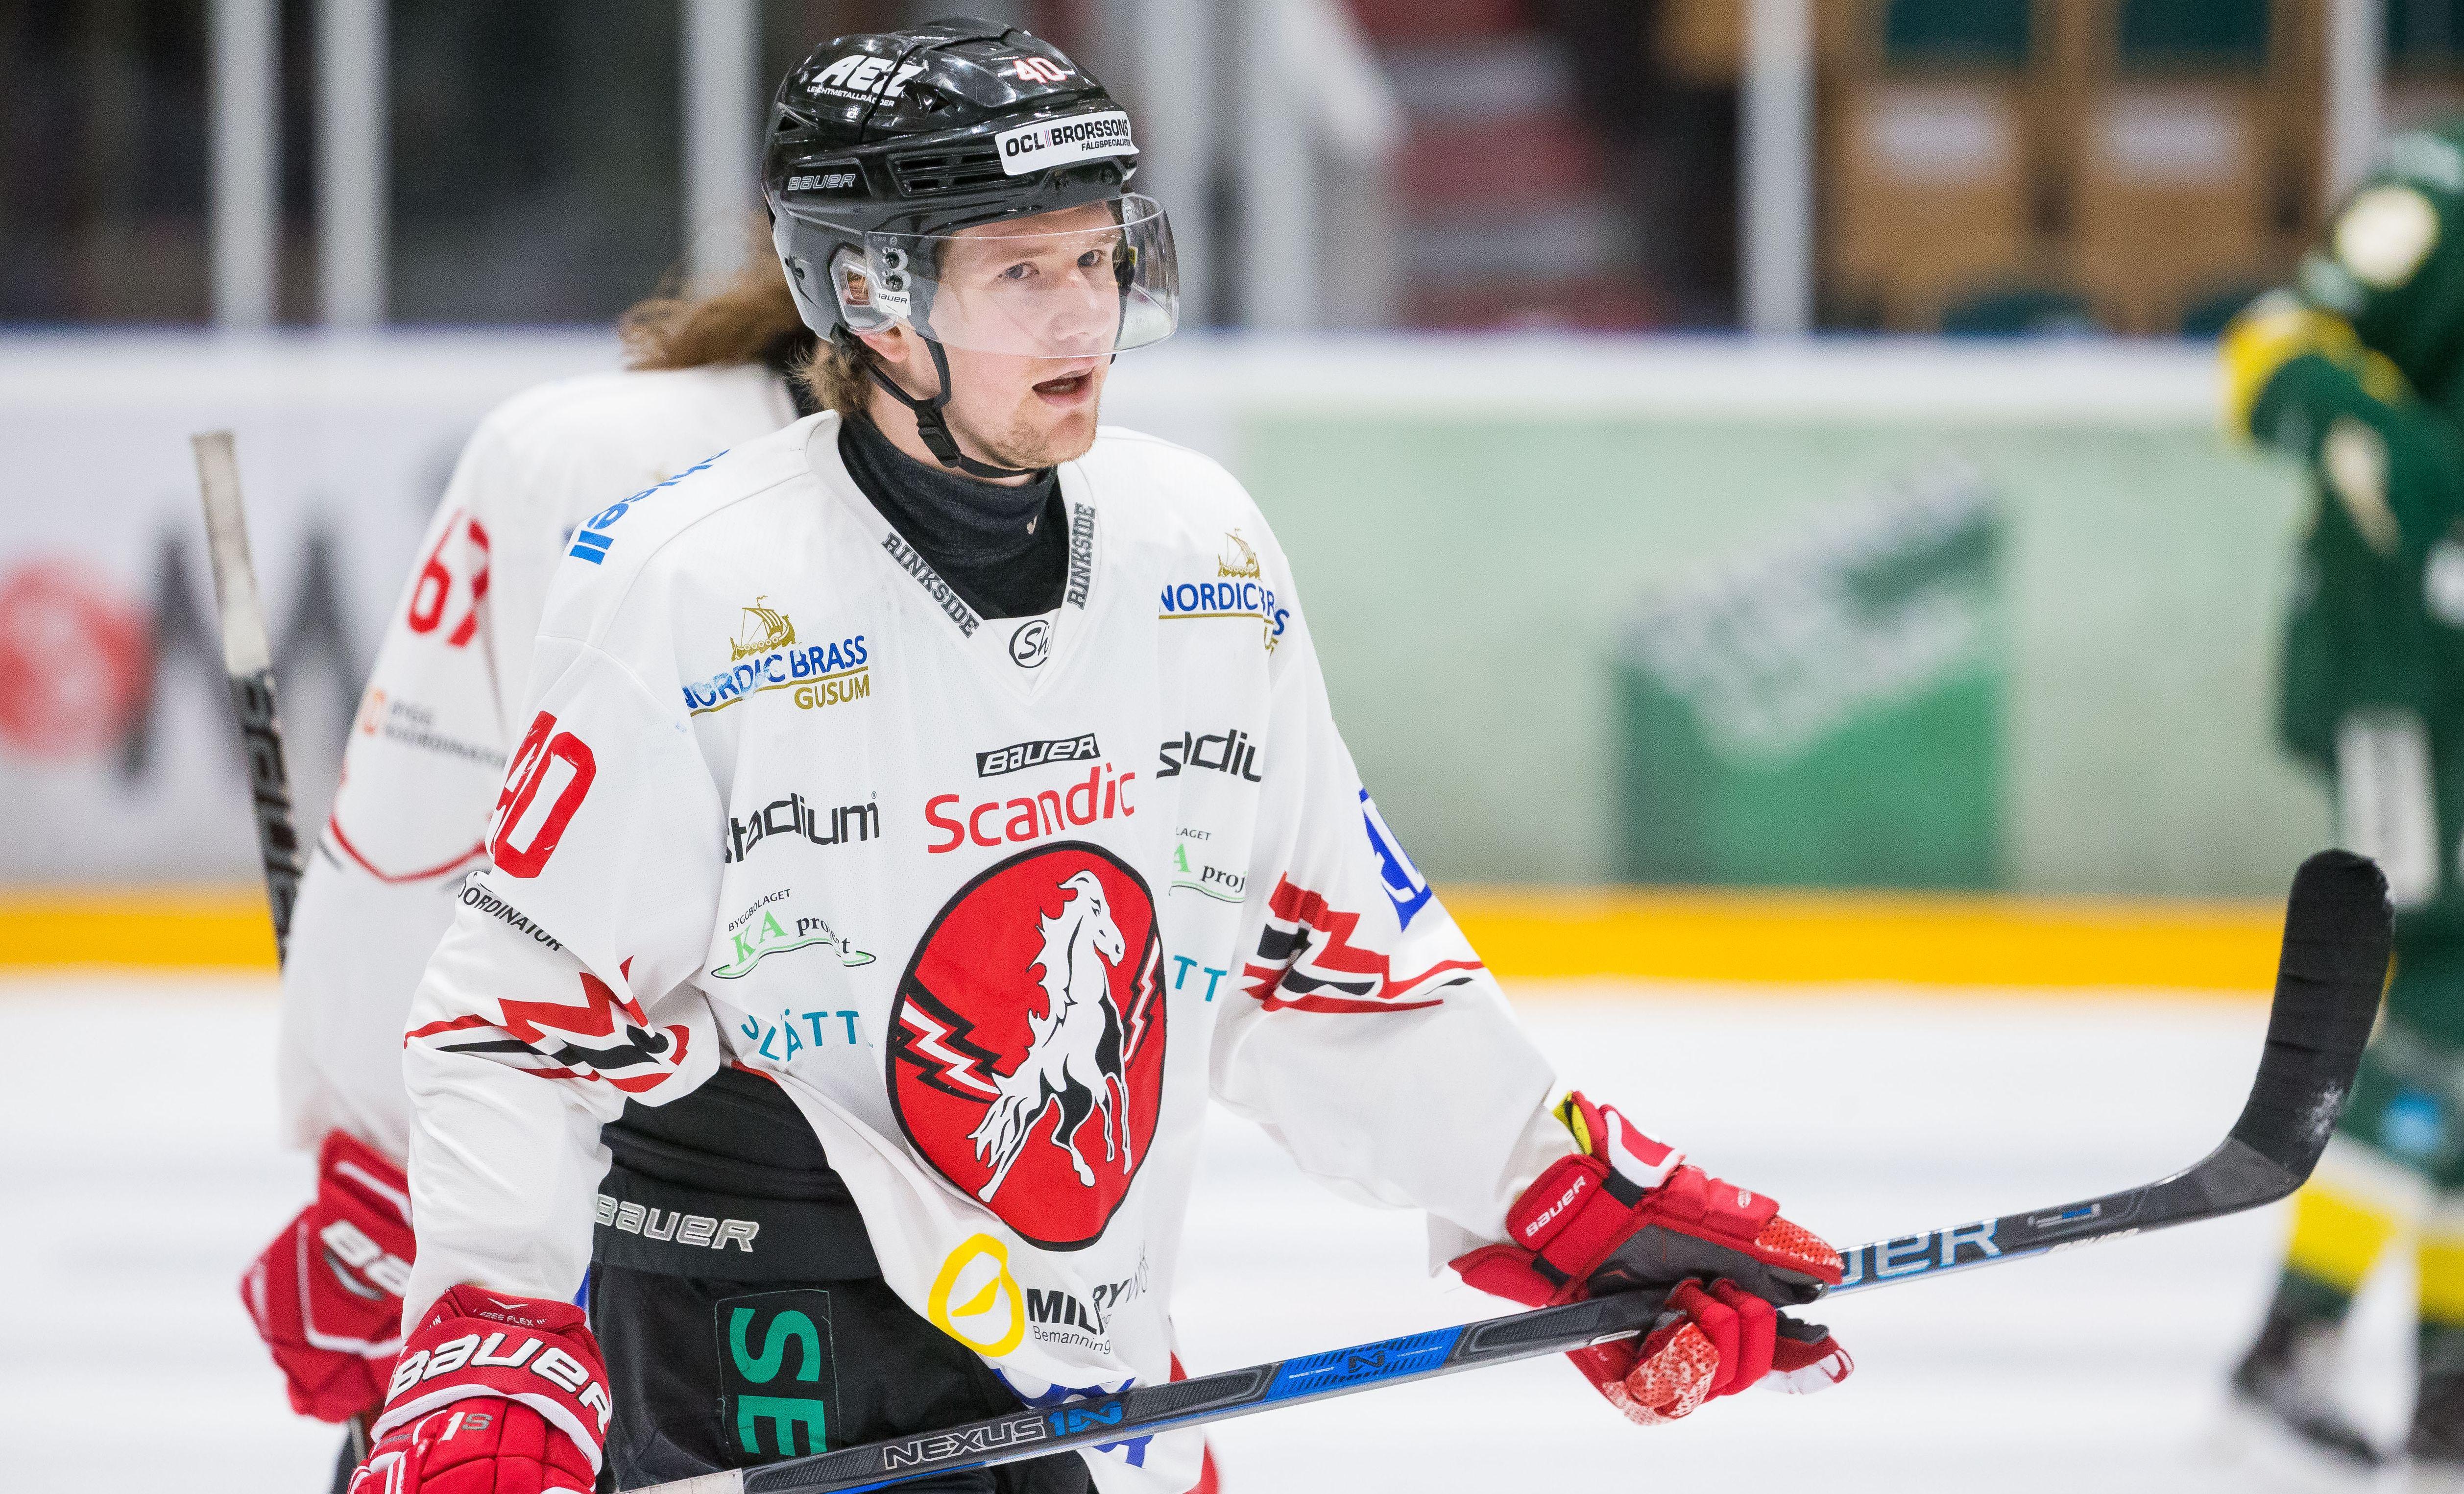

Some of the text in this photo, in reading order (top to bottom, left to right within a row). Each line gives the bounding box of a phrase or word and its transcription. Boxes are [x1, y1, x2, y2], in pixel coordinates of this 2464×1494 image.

[1013, 57, 1067, 84] 40
[1006, 119, 1129, 157] OCL BRORSSONS
[788, 173, 856, 191] BAUER
[1067, 501, 1096, 610] RINKSIDE
[881, 532, 980, 639] RINKSIDE
[1159, 582, 1258, 612] NORDIC
[682, 635, 868, 710] NORDIC BRASS
[794, 674, 870, 710] GUSUM
[982, 735, 1096, 775] BAUER
[490, 710, 597, 879] 40
[925, 762, 1135, 854] Scandic
[728, 888, 791, 932] BYGGBOLAGET
[730, 909, 789, 966] KA
[594, 1193, 759, 1252] BAUER
[1525, 1175, 1587, 1237] BAUER
[1032, 1325, 1111, 1355] Bemanning
[384, 1332, 612, 1436] BAUER
[440, 1412, 494, 1441] 1S
[883, 1415, 1047, 1470] NEXUS
